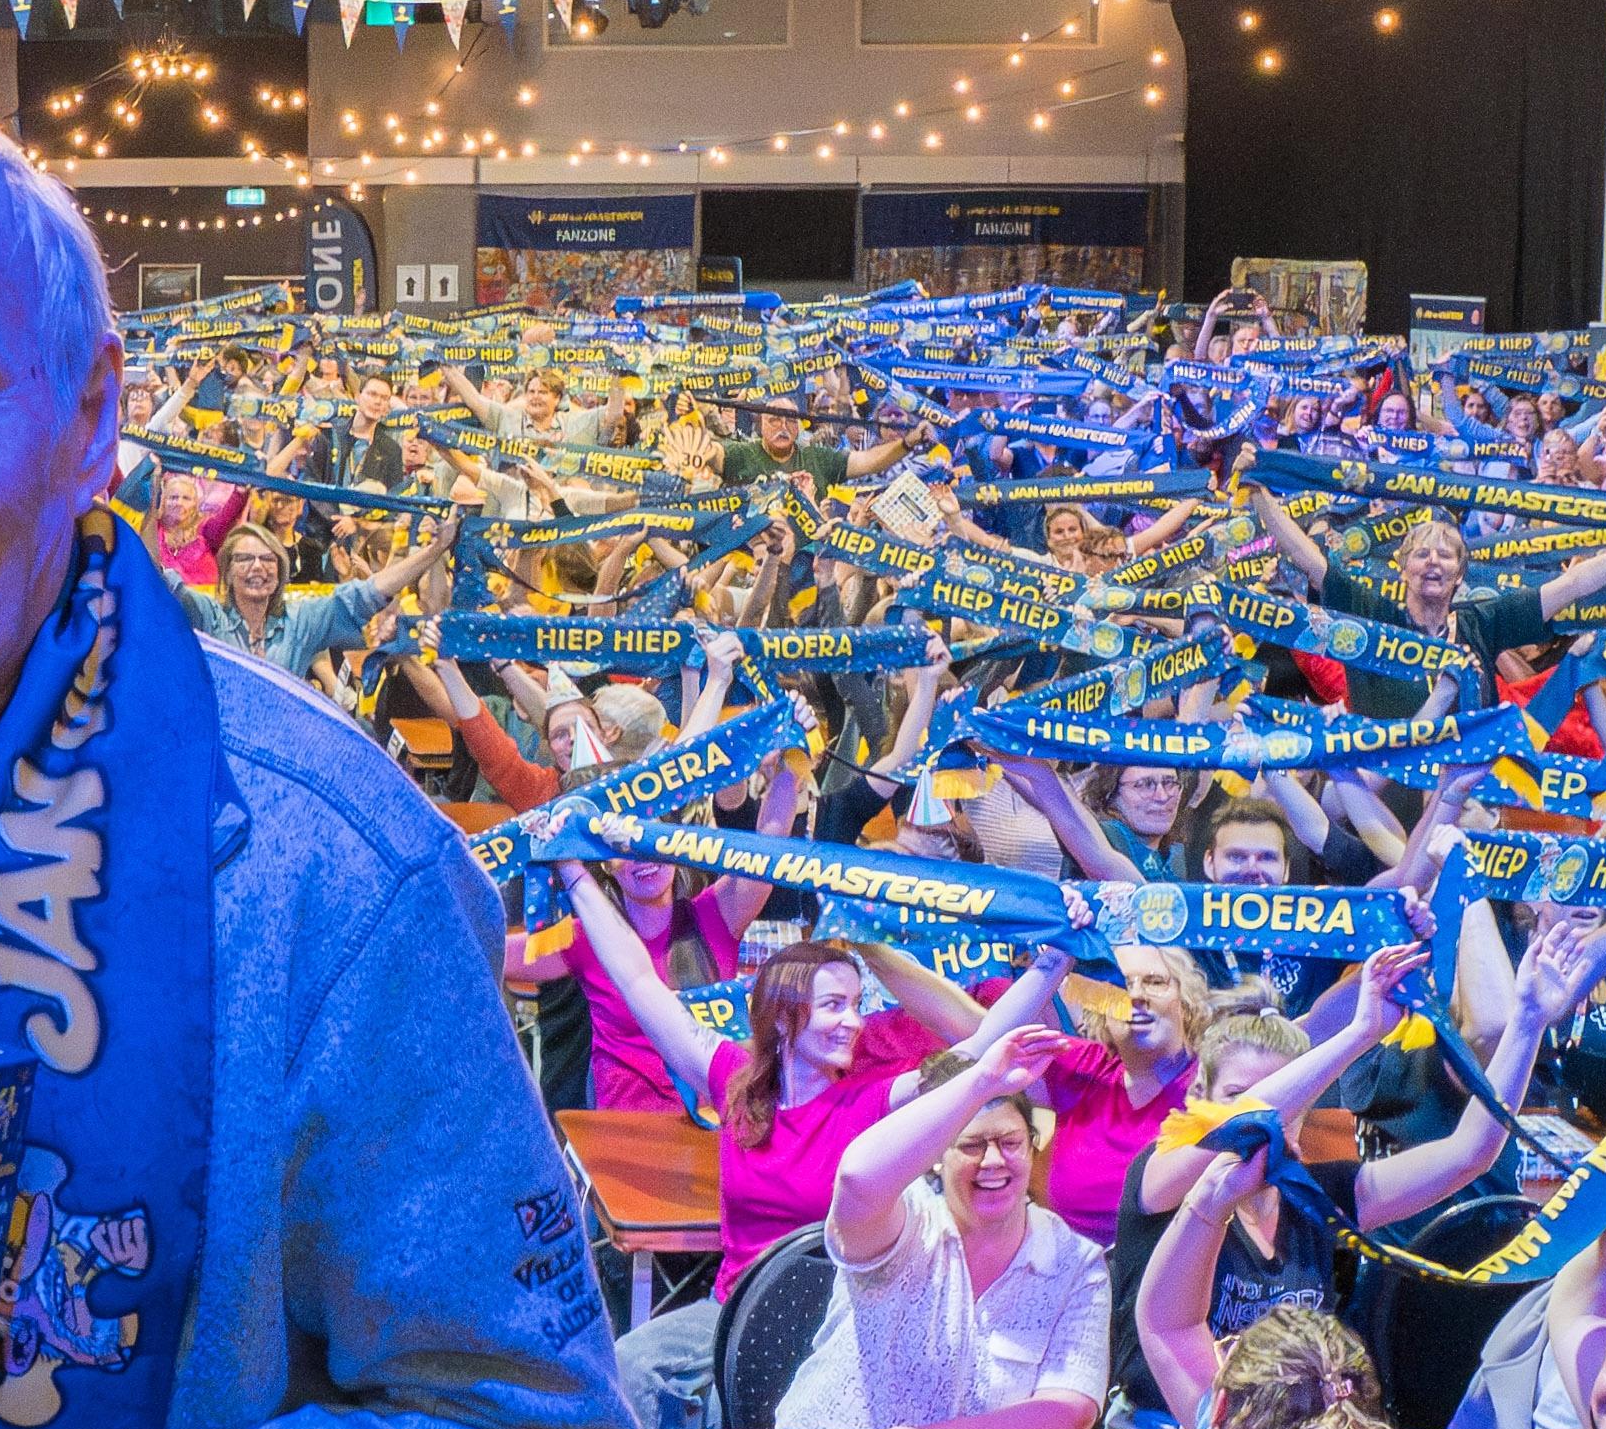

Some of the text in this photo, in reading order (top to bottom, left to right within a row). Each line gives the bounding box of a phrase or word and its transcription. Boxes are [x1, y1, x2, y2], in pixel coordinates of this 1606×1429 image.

[555, 228, 616, 244] FANZONE
[445, 347, 605, 363] HIEP HIEP HOERA
[1289, 377, 1342, 393] HOERA
[1048, 425, 1126, 445] HAASTEREN
[1393, 437, 1428, 451] HIEP
[682, 454, 701, 466] 30
[1009, 480, 1153, 499] JAN HAASTEREN
[1386, 475, 1435, 495] JAN
[1437, 485, 1470, 499] VAN
[881, 544, 934, 572] HIEP
[934, 580, 1059, 629] HIEP HIEP
[536, 629, 852, 658] HIEP HIEP HOERA
[1027, 719, 1211, 754] HIEP HIEP
[607, 742, 731, 812] HOERA
[725, 851, 995, 916] VAN HAASTEREN
[1202, 894, 1354, 934] HOERA
